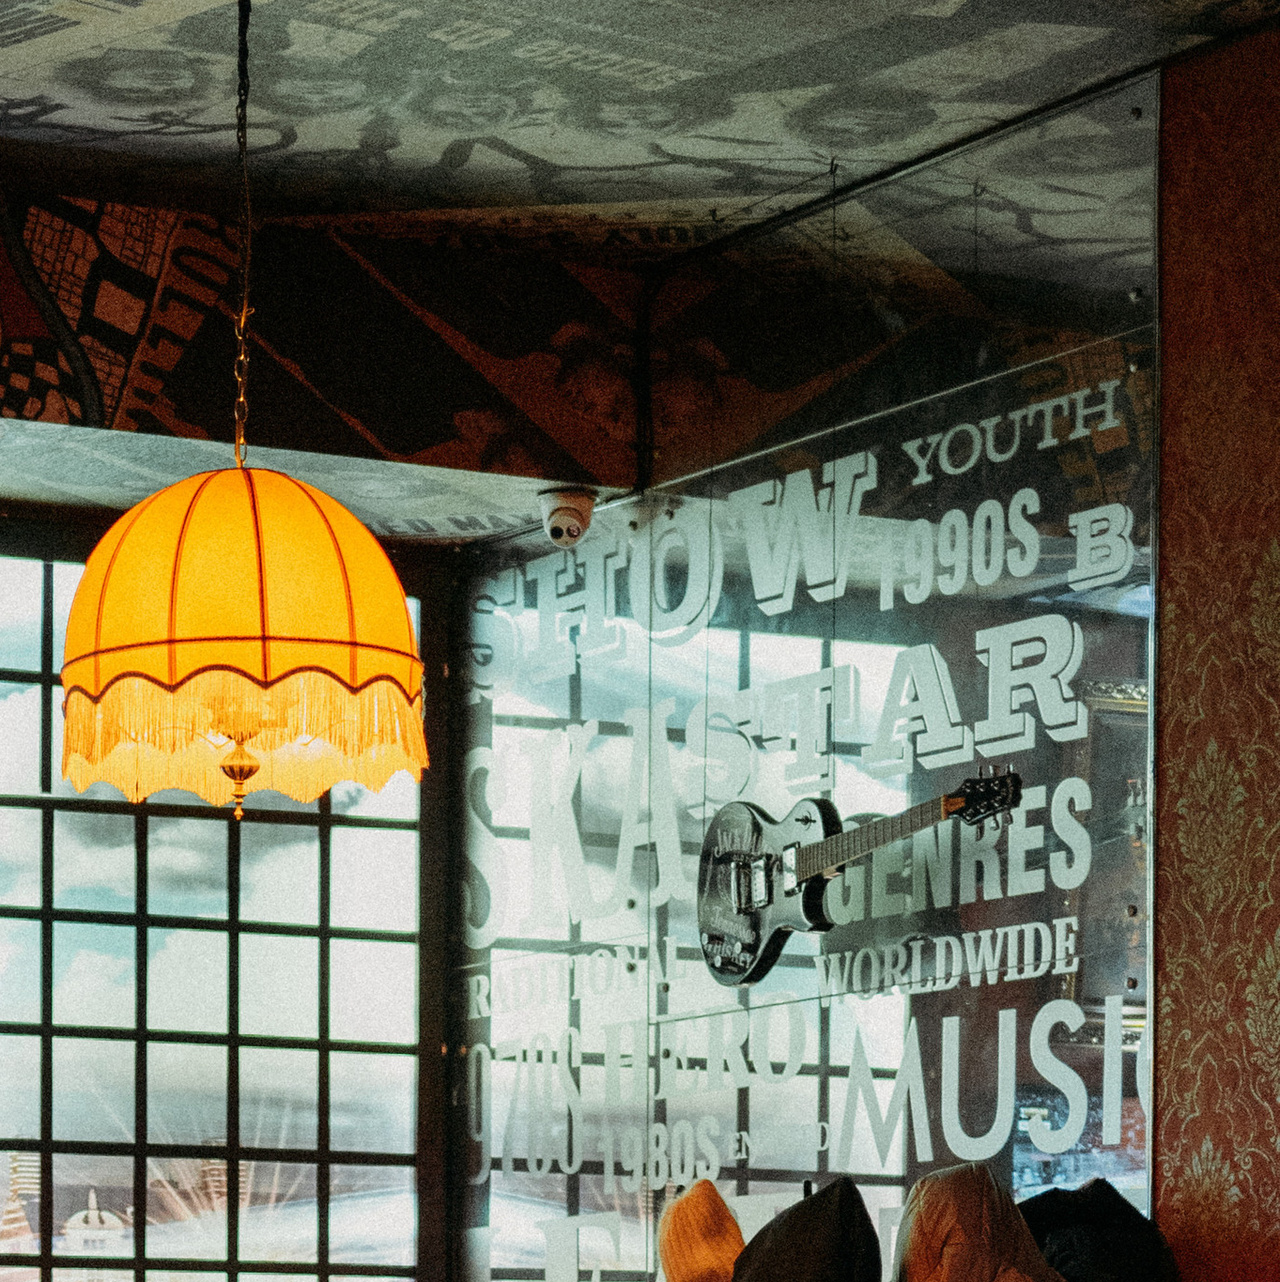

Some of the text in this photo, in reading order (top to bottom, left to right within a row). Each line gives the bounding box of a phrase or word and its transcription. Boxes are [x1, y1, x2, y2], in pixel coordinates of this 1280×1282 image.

[900, 376, 1122, 487] YOUTH
[878, 487, 1042, 612] 1990S
[685, 612, 1089, 808] STAR
[824, 776, 1094, 927] GENRES
[814, 916, 1080, 1007] WORLDWIDE
